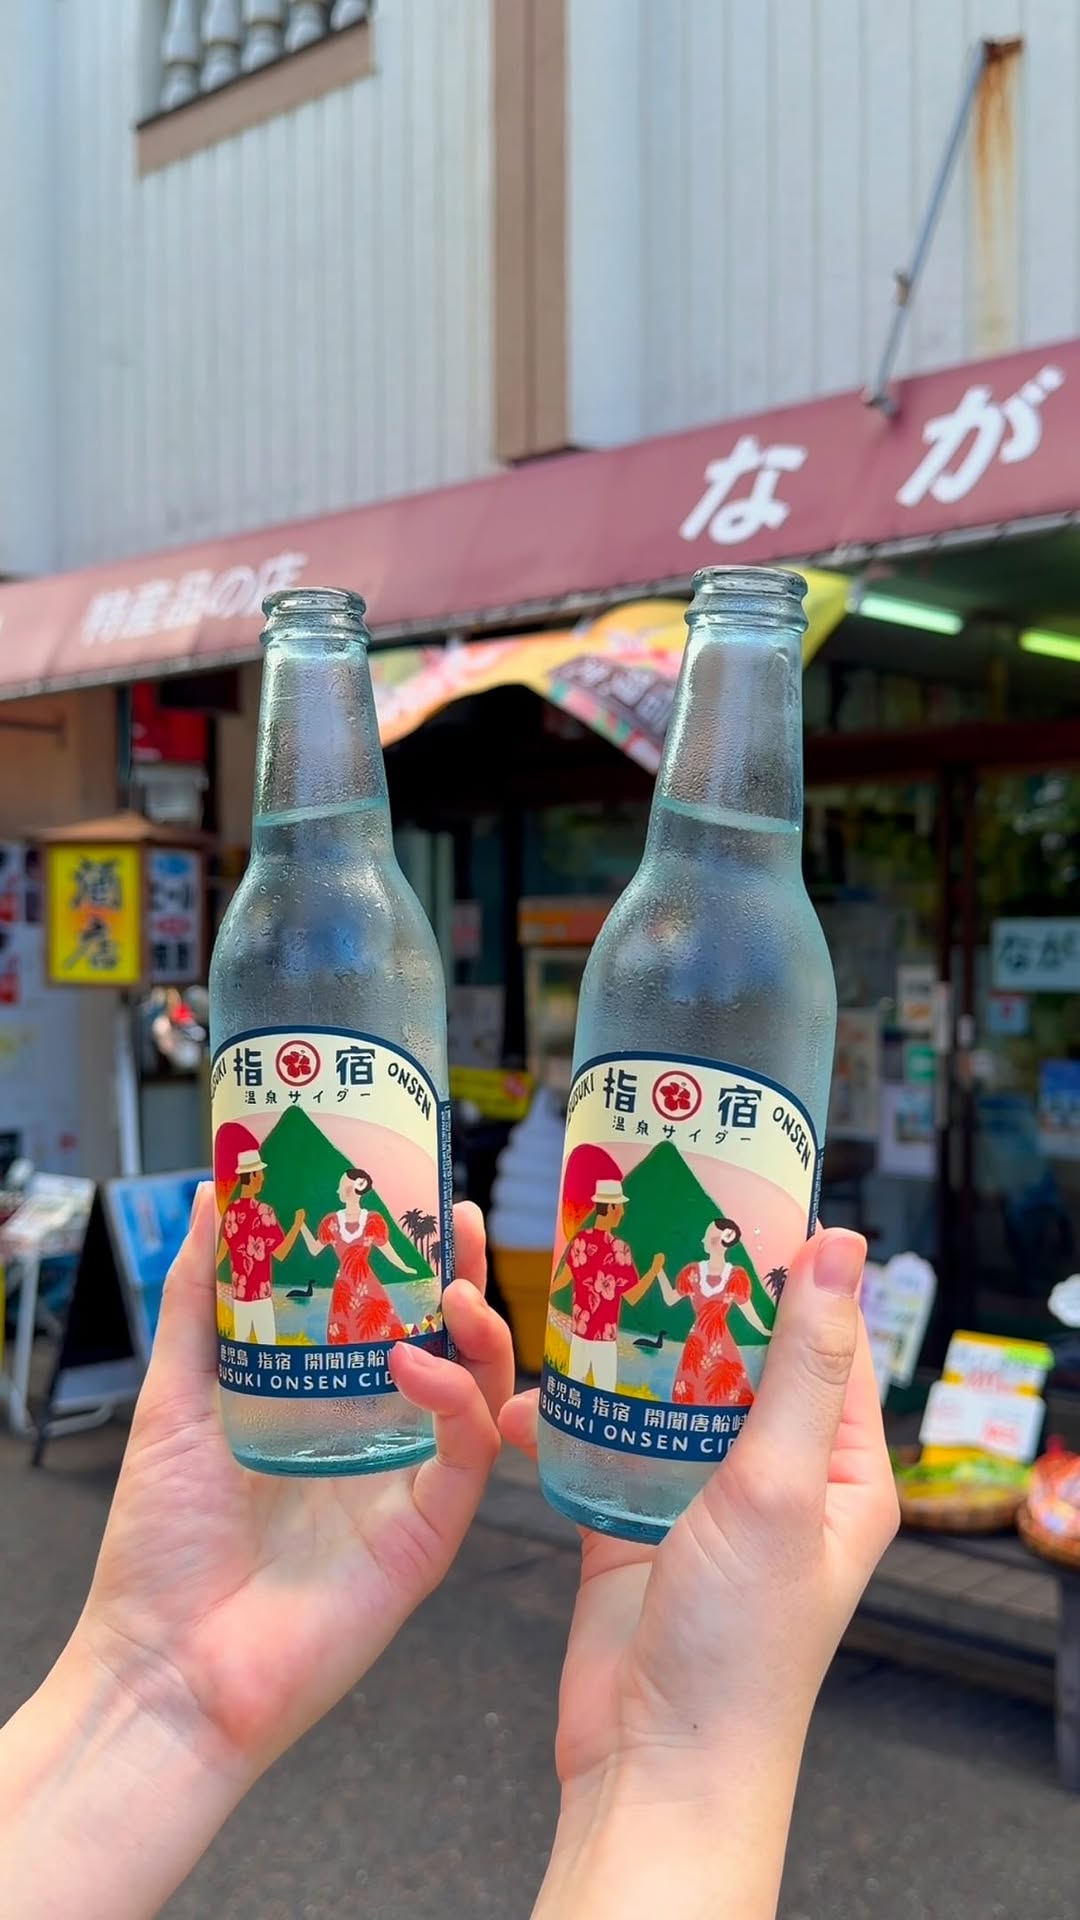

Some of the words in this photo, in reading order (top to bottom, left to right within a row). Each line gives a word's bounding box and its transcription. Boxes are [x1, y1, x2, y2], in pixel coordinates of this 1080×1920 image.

[244, 1088, 371, 1105] 温泉サイダー
[387, 1062, 432, 1121] ONSEN
[612, 1115, 751, 1145] 温泉サイダー
[772, 1106, 811, 1171] ONSEN
[220, 1344, 249, 1367] 鹿児島
[257, 1351, 292, 1371] 指宿
[304, 1349, 393, 1371] 開聞唐船
[270, 1374, 347, 1391] ONSEN
[546, 1375, 582, 1410] 鹿児島
[592, 1395, 631, 1423] 指宿
[603, 1424, 688, 1452] ONSEN
